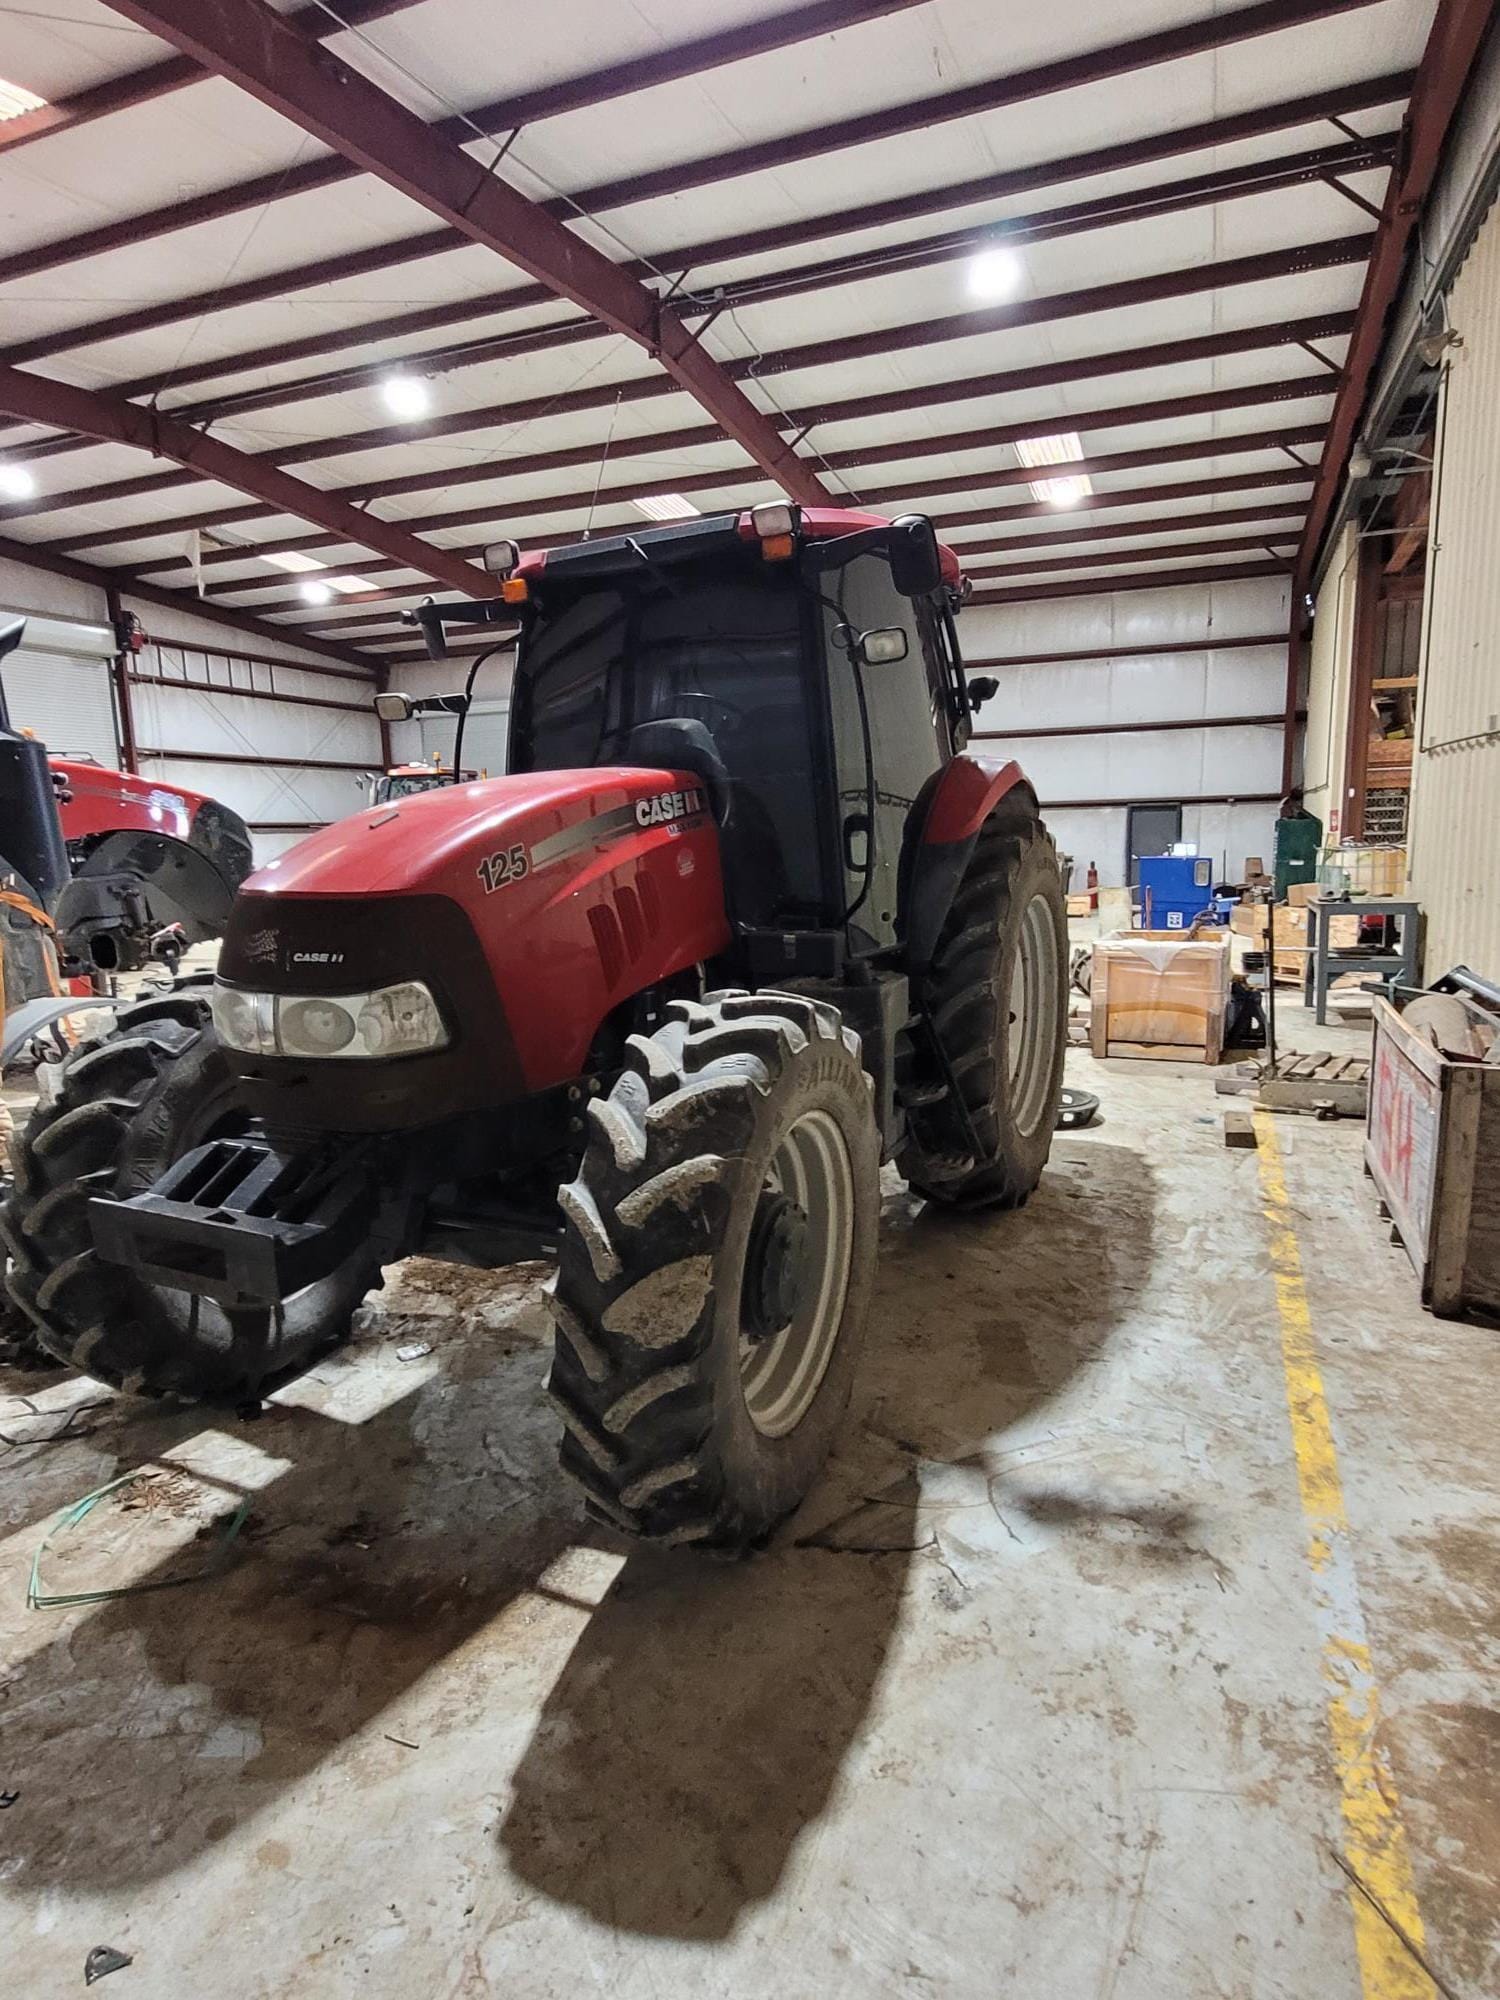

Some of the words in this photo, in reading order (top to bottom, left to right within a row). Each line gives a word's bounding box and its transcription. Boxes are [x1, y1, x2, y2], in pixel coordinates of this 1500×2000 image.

[636, 792, 685, 826] CASE
[477, 842, 528, 894] 125
[293, 952, 329, 962] CASE
